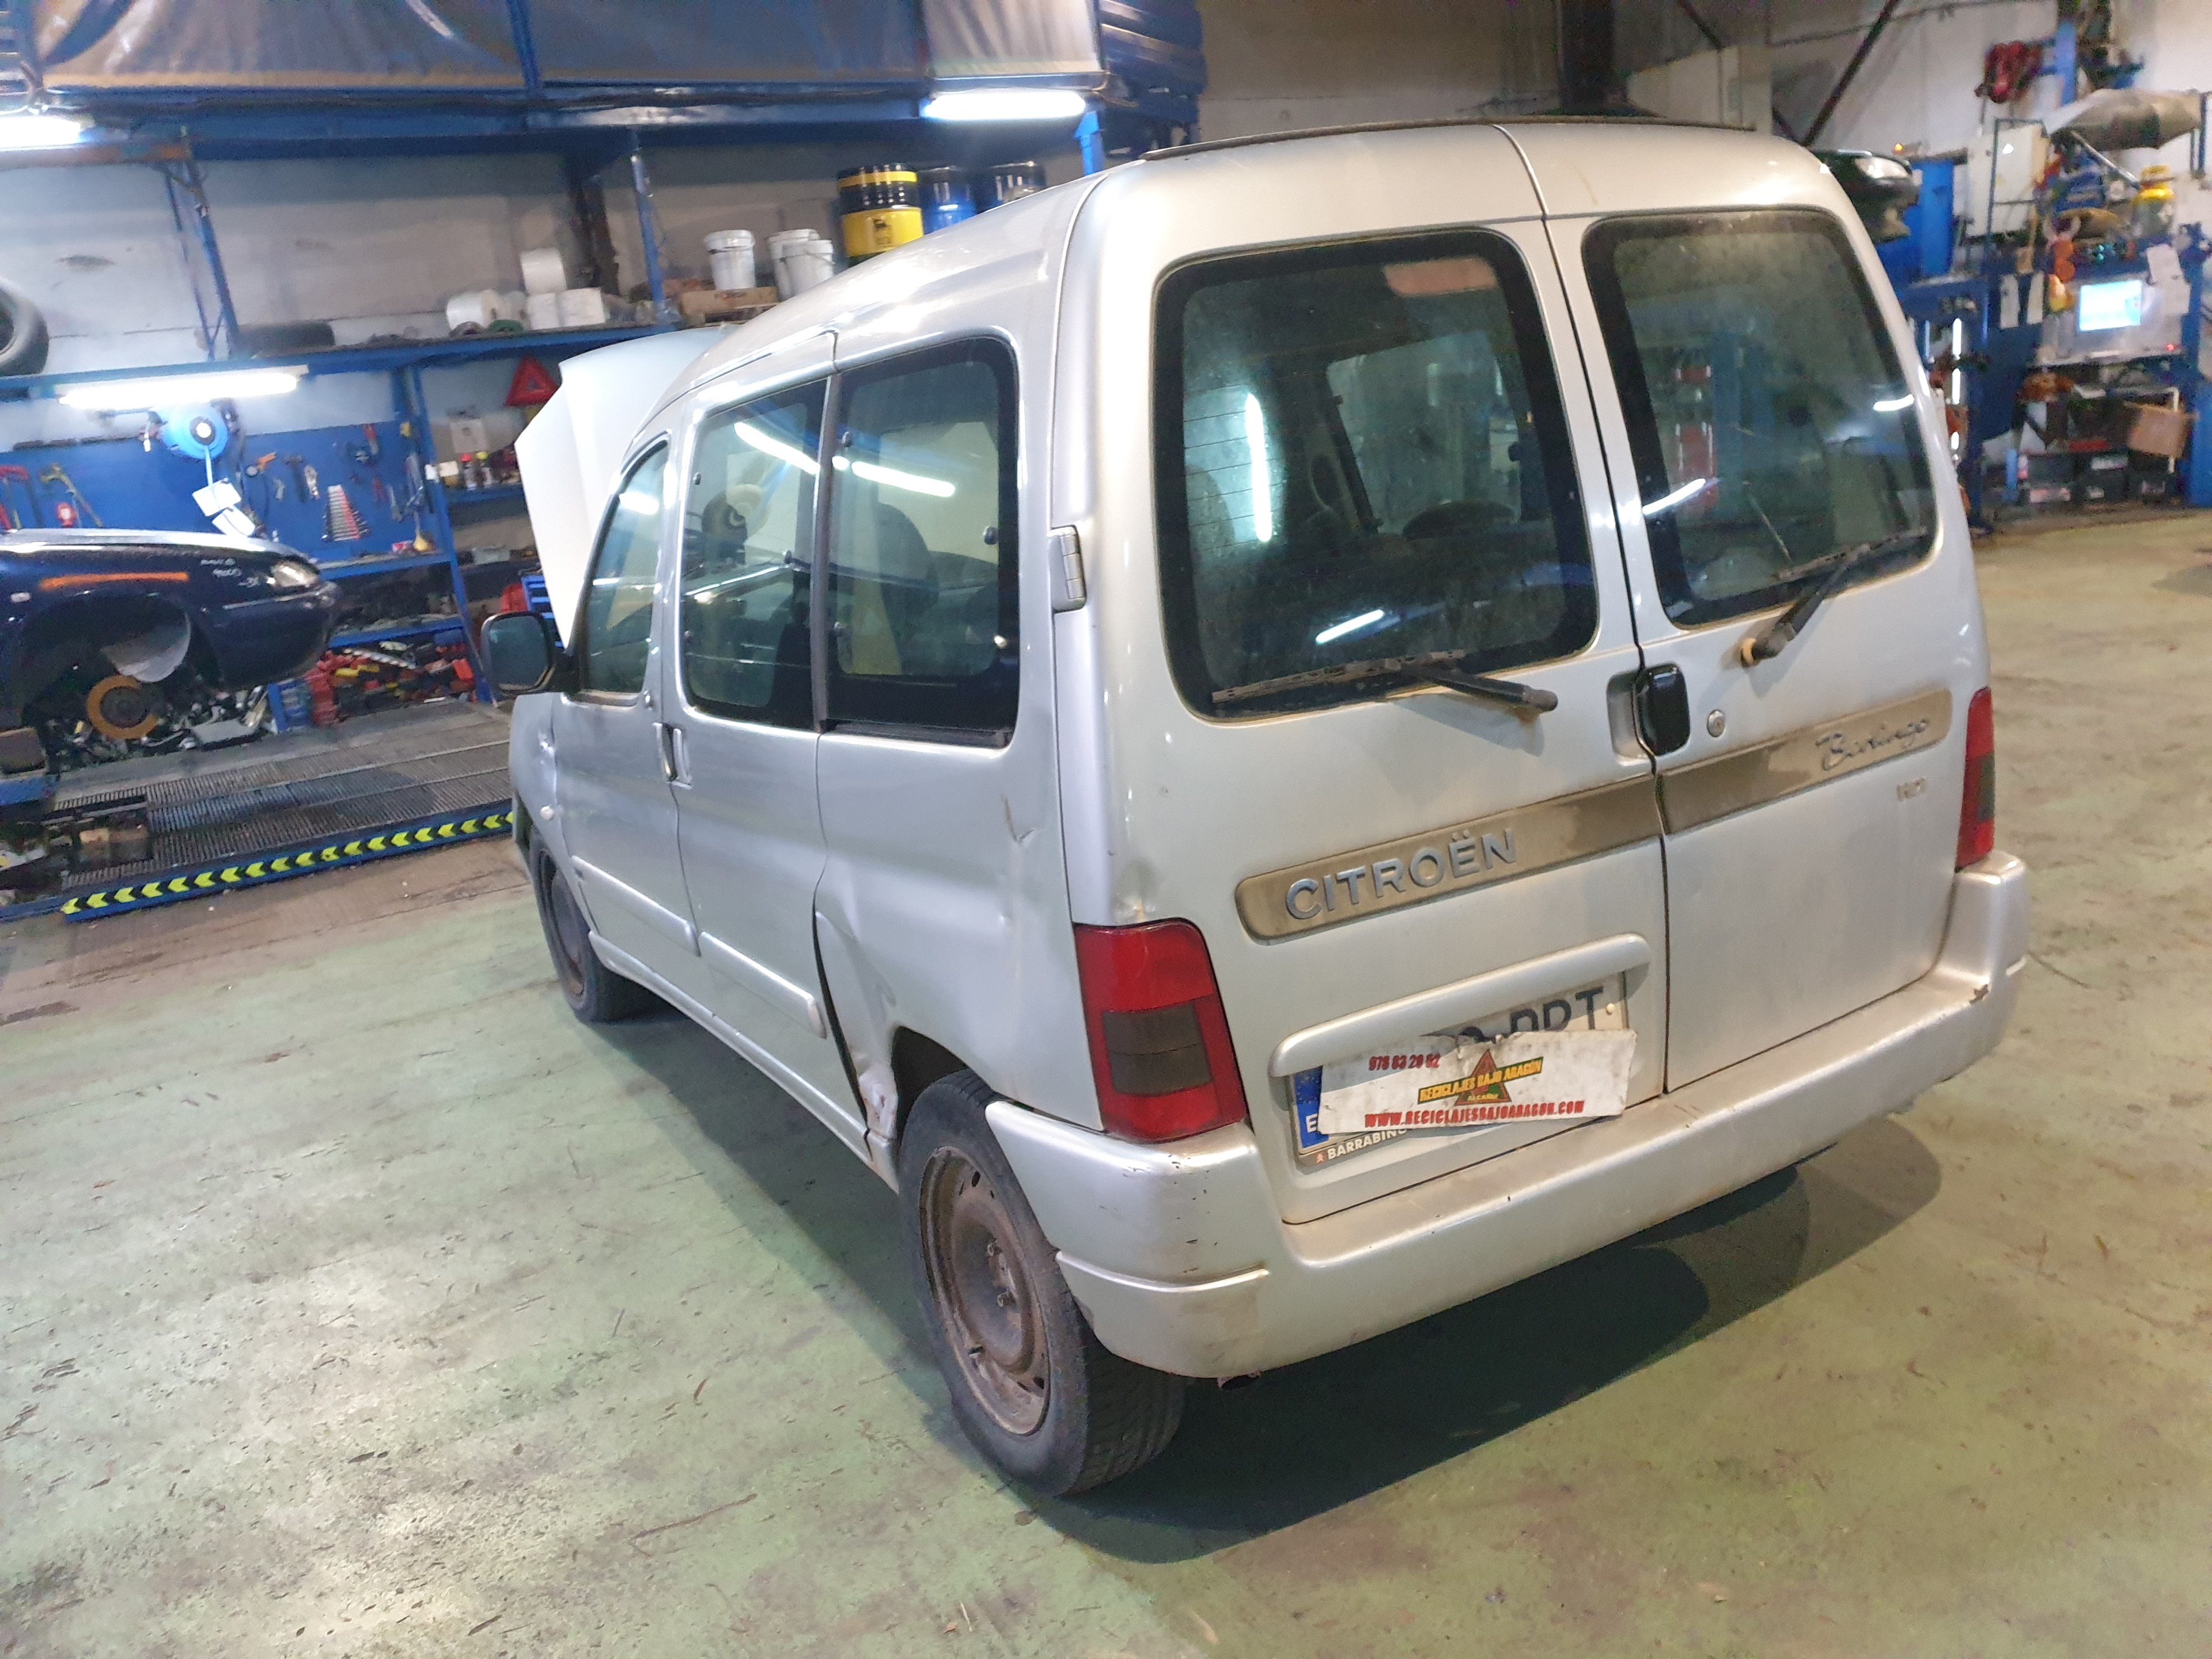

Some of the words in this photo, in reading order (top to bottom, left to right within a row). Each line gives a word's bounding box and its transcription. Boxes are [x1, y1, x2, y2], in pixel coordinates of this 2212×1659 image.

[1285, 827, 1517, 921] CITROËN
[1419, 1077, 1476, 1102] RECICLAJES
[1305, 1113, 1318, 1133] E
